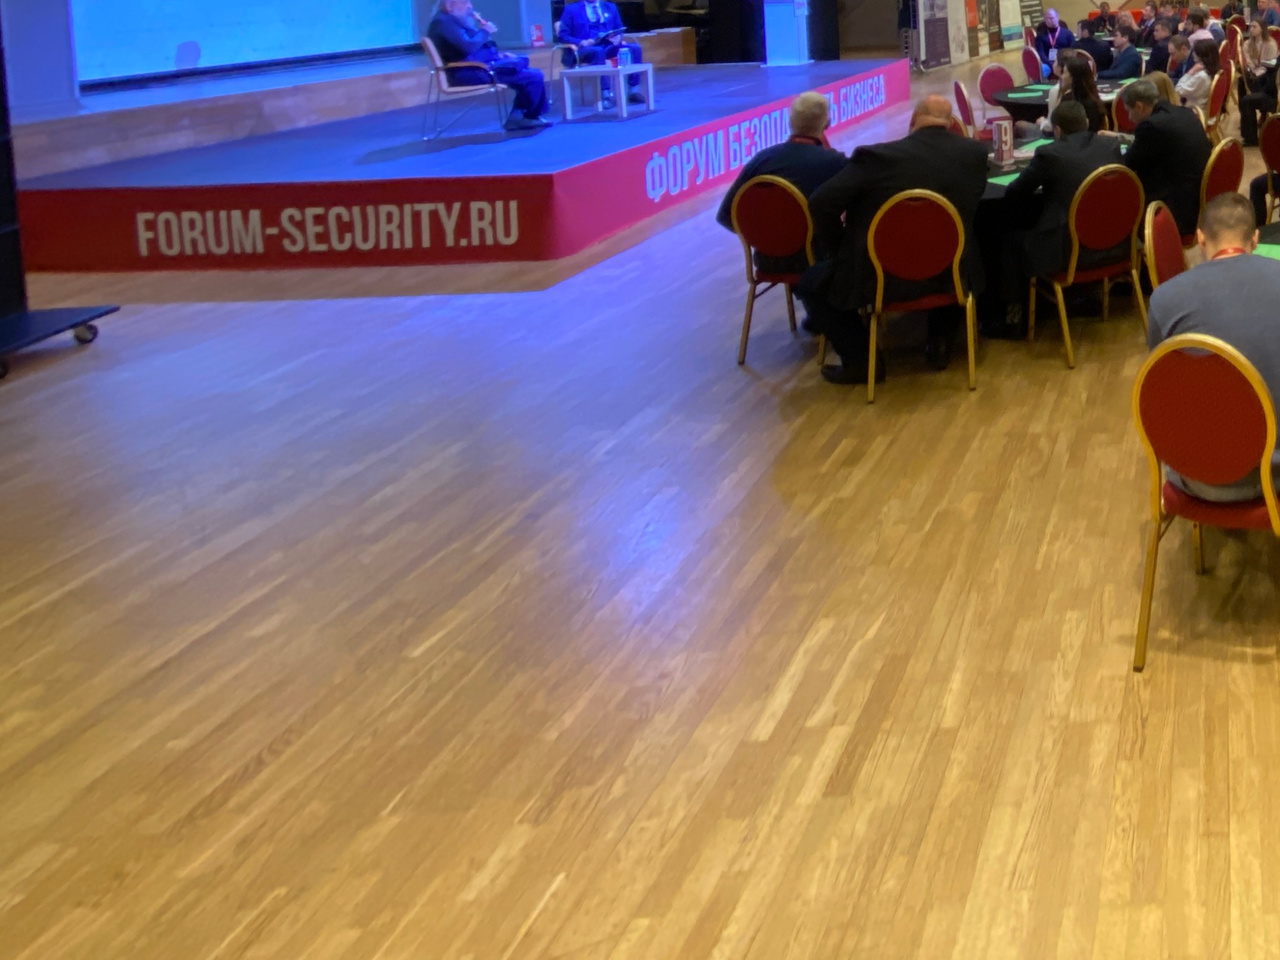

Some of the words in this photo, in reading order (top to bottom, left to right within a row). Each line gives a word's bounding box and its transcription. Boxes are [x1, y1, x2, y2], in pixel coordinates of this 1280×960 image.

[645, 130, 725, 203] ФОРУМ
[840, 74, 885, 123] БИЗНЕСА
[1001, 121, 1011, 151] 9
[136, 200, 519, 257] FORUM-SECURITY.RU
